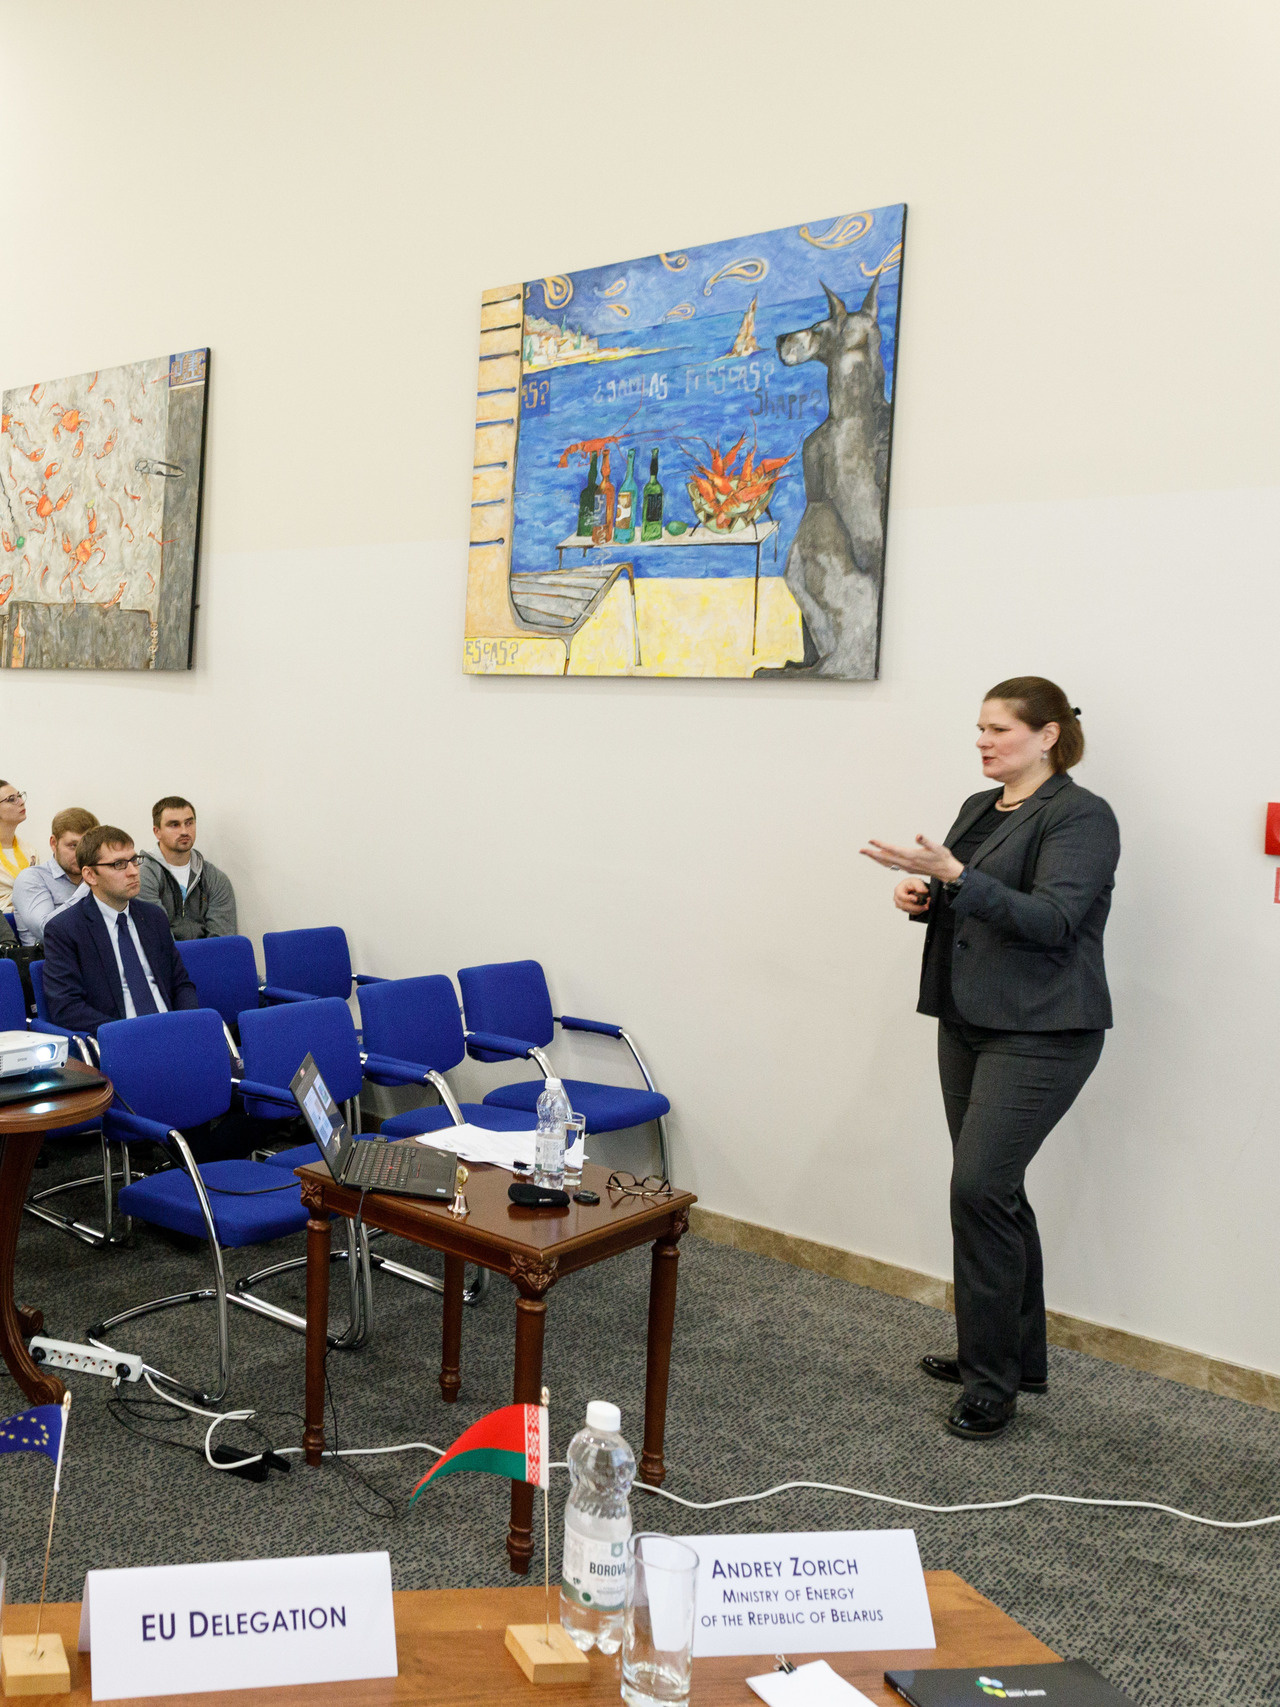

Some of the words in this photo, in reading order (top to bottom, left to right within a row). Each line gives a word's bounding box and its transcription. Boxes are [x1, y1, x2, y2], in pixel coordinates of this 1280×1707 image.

[711, 1558, 783, 1580] ANDREY
[788, 1556, 860, 1578] ZORICH
[722, 1588, 780, 1604] MINISTRY
[784, 1589, 802, 1602] OF
[805, 1586, 856, 1602] ENERGY
[140, 1611, 177, 1643] EU
[188, 1604, 348, 1639] DELEGATION
[700, 1614, 718, 1628] OF
[721, 1613, 744, 1627] THE
[746, 1610, 806, 1626] REPUBLIC
[809, 1611, 827, 1624] OF
[830, 1608, 885, 1624] BELARUS
